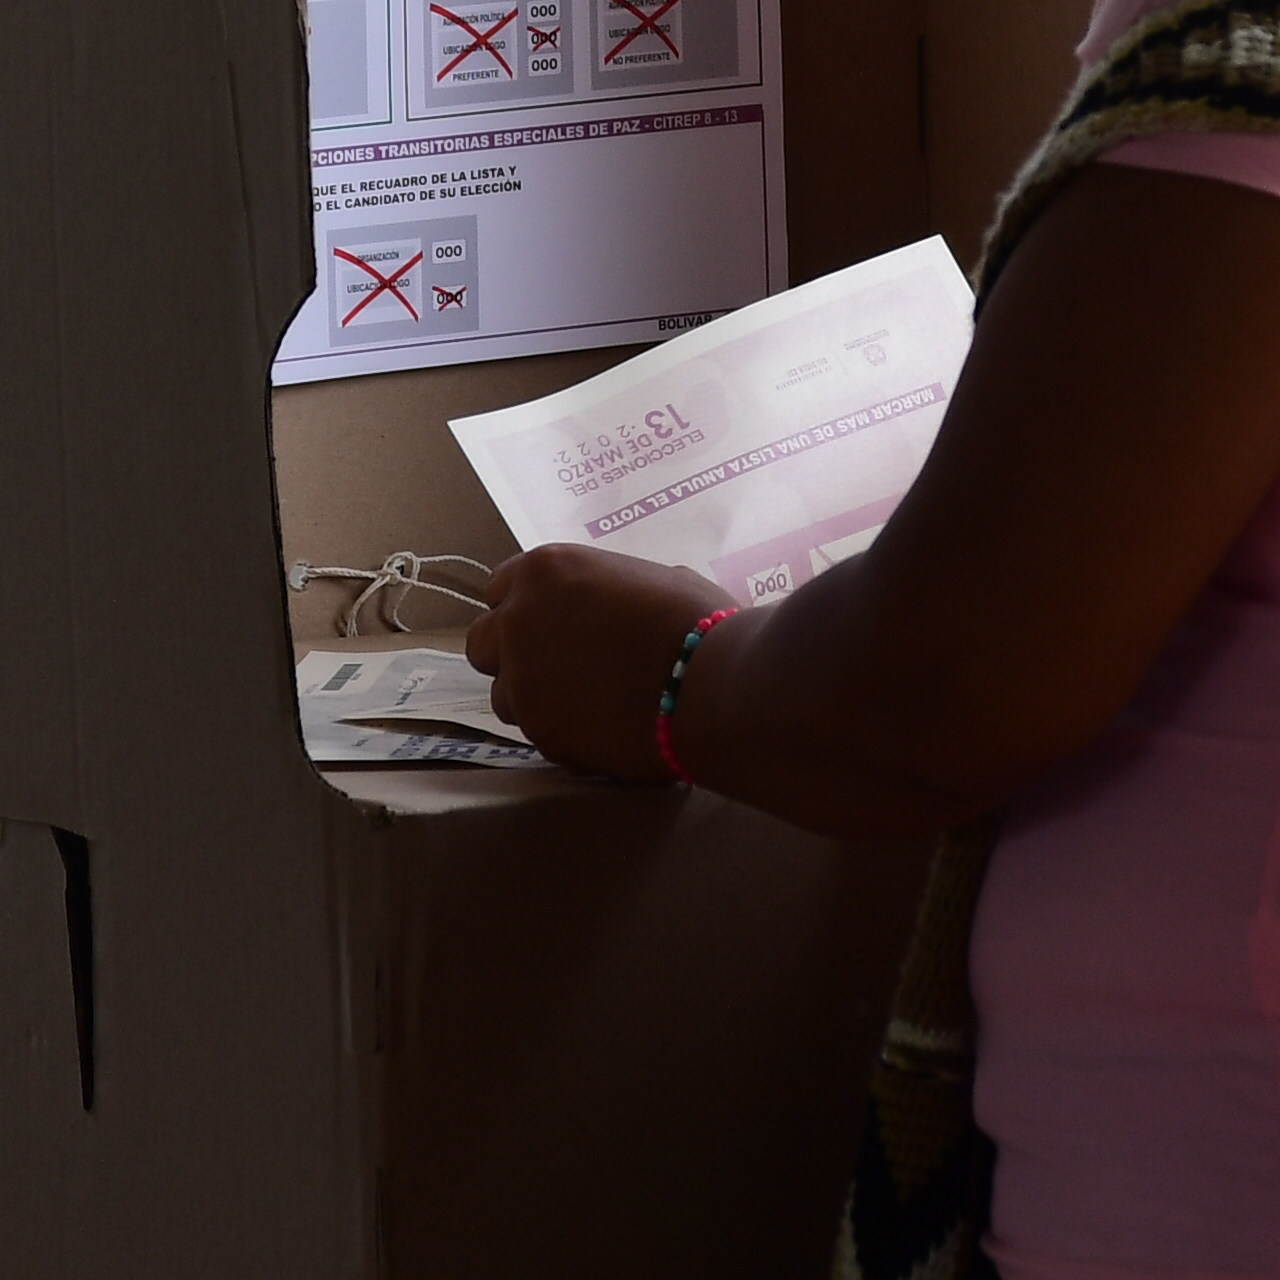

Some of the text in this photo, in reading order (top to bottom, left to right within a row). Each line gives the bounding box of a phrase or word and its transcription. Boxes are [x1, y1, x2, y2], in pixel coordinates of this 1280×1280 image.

[531, 4, 557, 16] 000
[453, 70, 499, 81] PREFERENTE
[532, 59, 558, 71] 000
[379, 135, 489, 158] TRANSITORIAS
[494, 124, 584, 145] ESPECIALES
[589, 123, 608, 135] DE
[613, 119, 640, 133] PAZ
[654, 114, 700, 129] CITREP
[723, 110, 737, 122] 13
[341, 182, 356, 192] EL
[360, 176, 427, 191] RECUADRO
[432, 173, 447, 184] DE
[452, 172, 466, 182] LA
[470, 168, 504, 180] LISTA
[508, 166, 516, 176] Y
[326, 200, 341, 210] EL
[345, 193, 415, 208] CANDIDATO
[420, 190, 435, 200] DE
[440, 187, 456, 198] SU
[461, 179, 521, 196] ELECCIÓN
[436, 246, 462, 258] 000
[871, 389, 934, 419] MARCAR
[558, 404, 690, 483] 13 DE MARZO
[777, 434, 811, 454] UNA
[816, 425, 834, 440] DE
[566, 429, 705, 496] ELECCIONES DEL
[727, 447, 775, 473] LISTA
[671, 466, 724, 498] ANULA
[646, 493, 669, 508] EL
[599, 505, 646, 531] VOTO
